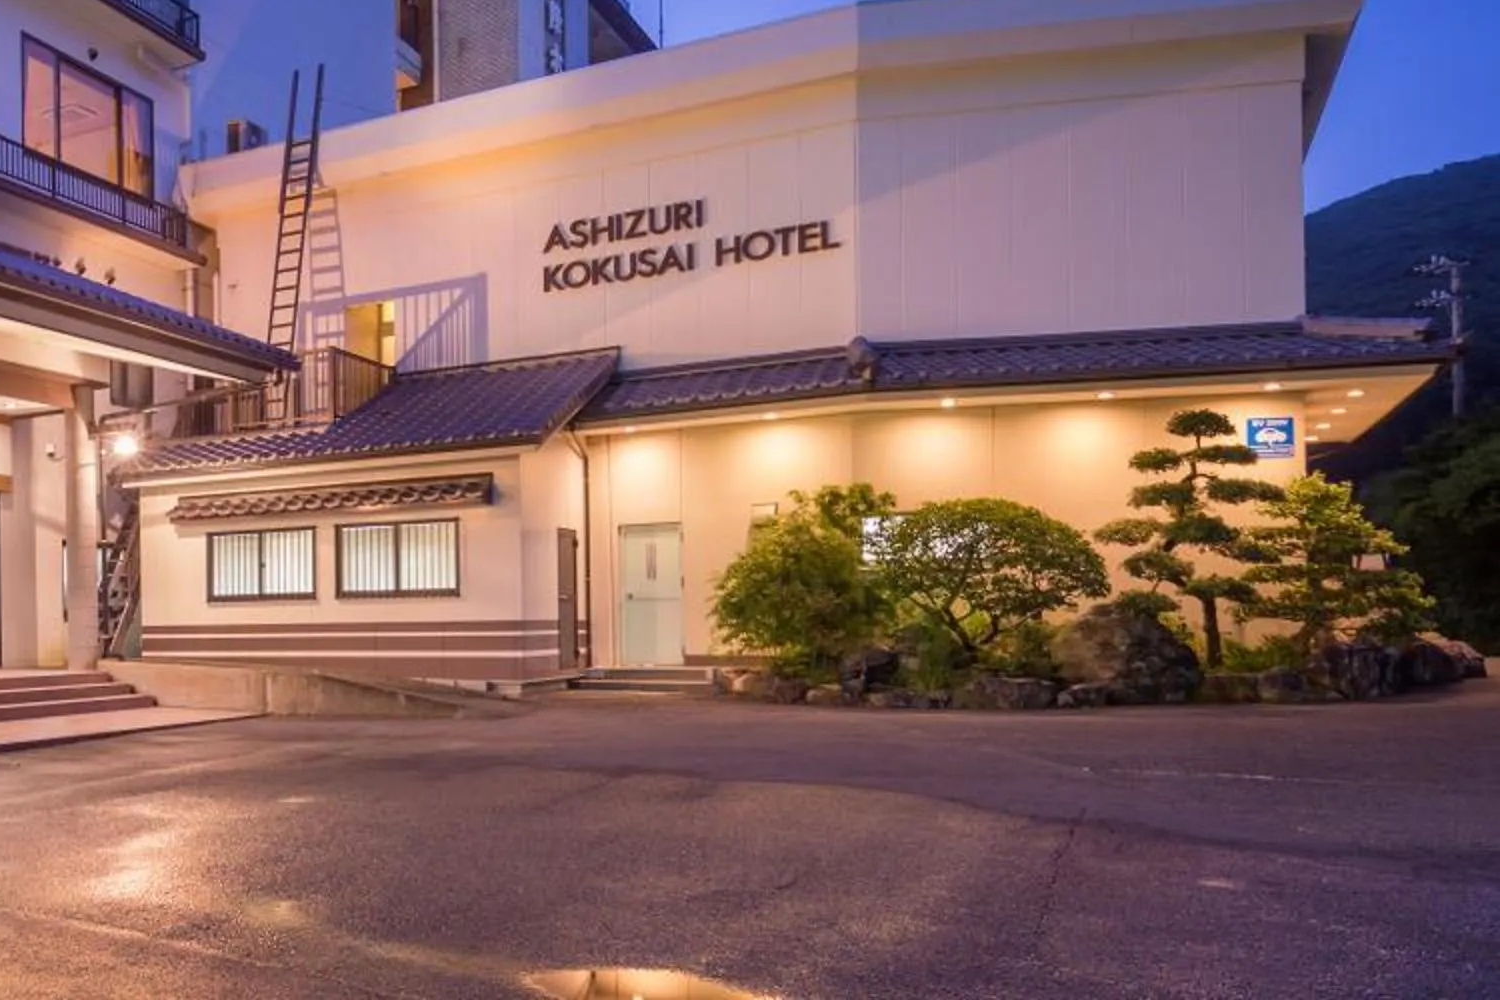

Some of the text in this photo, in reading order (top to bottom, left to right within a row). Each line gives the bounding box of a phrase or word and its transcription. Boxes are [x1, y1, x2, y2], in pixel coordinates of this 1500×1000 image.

[543, 199, 704, 253] ASHIZURI
[543, 220, 841, 292] KOKUSAI HOTEL
